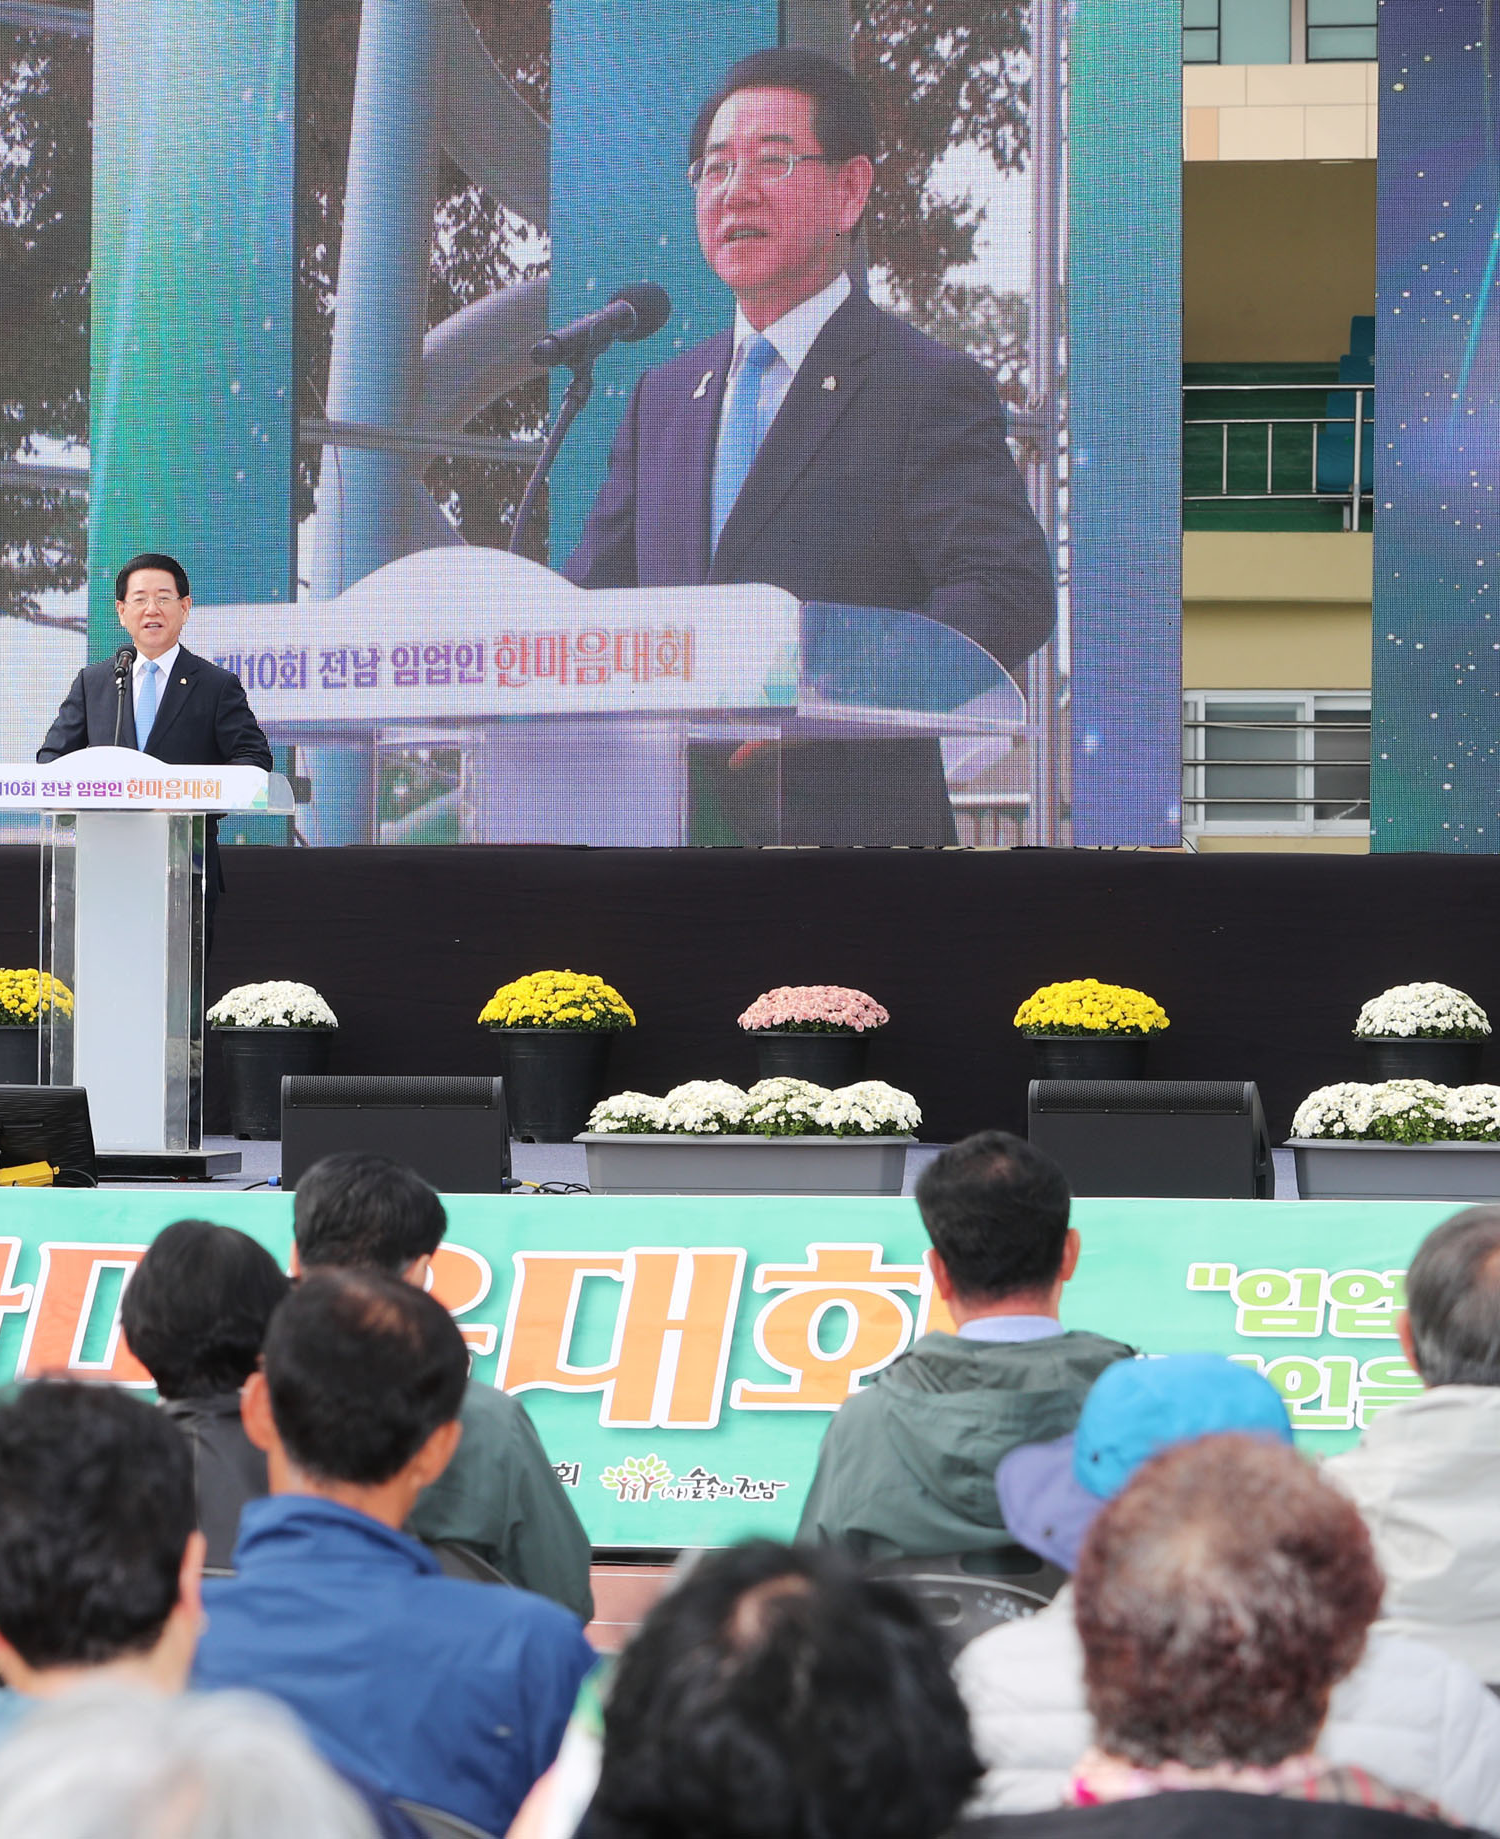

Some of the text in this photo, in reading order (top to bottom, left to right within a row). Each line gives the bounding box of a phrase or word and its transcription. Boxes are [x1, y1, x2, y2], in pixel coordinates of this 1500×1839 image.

[319, 649, 381, 689] 전남
[391, 643, 484, 686] 임업인
[494, 630, 694, 688] 한마음대회
[40, 781, 73, 798] 전남
[76, 781, 123, 798] 임업인
[126, 778, 223, 800] 한마음대회
[735, 1476, 787, 1500] 전남
